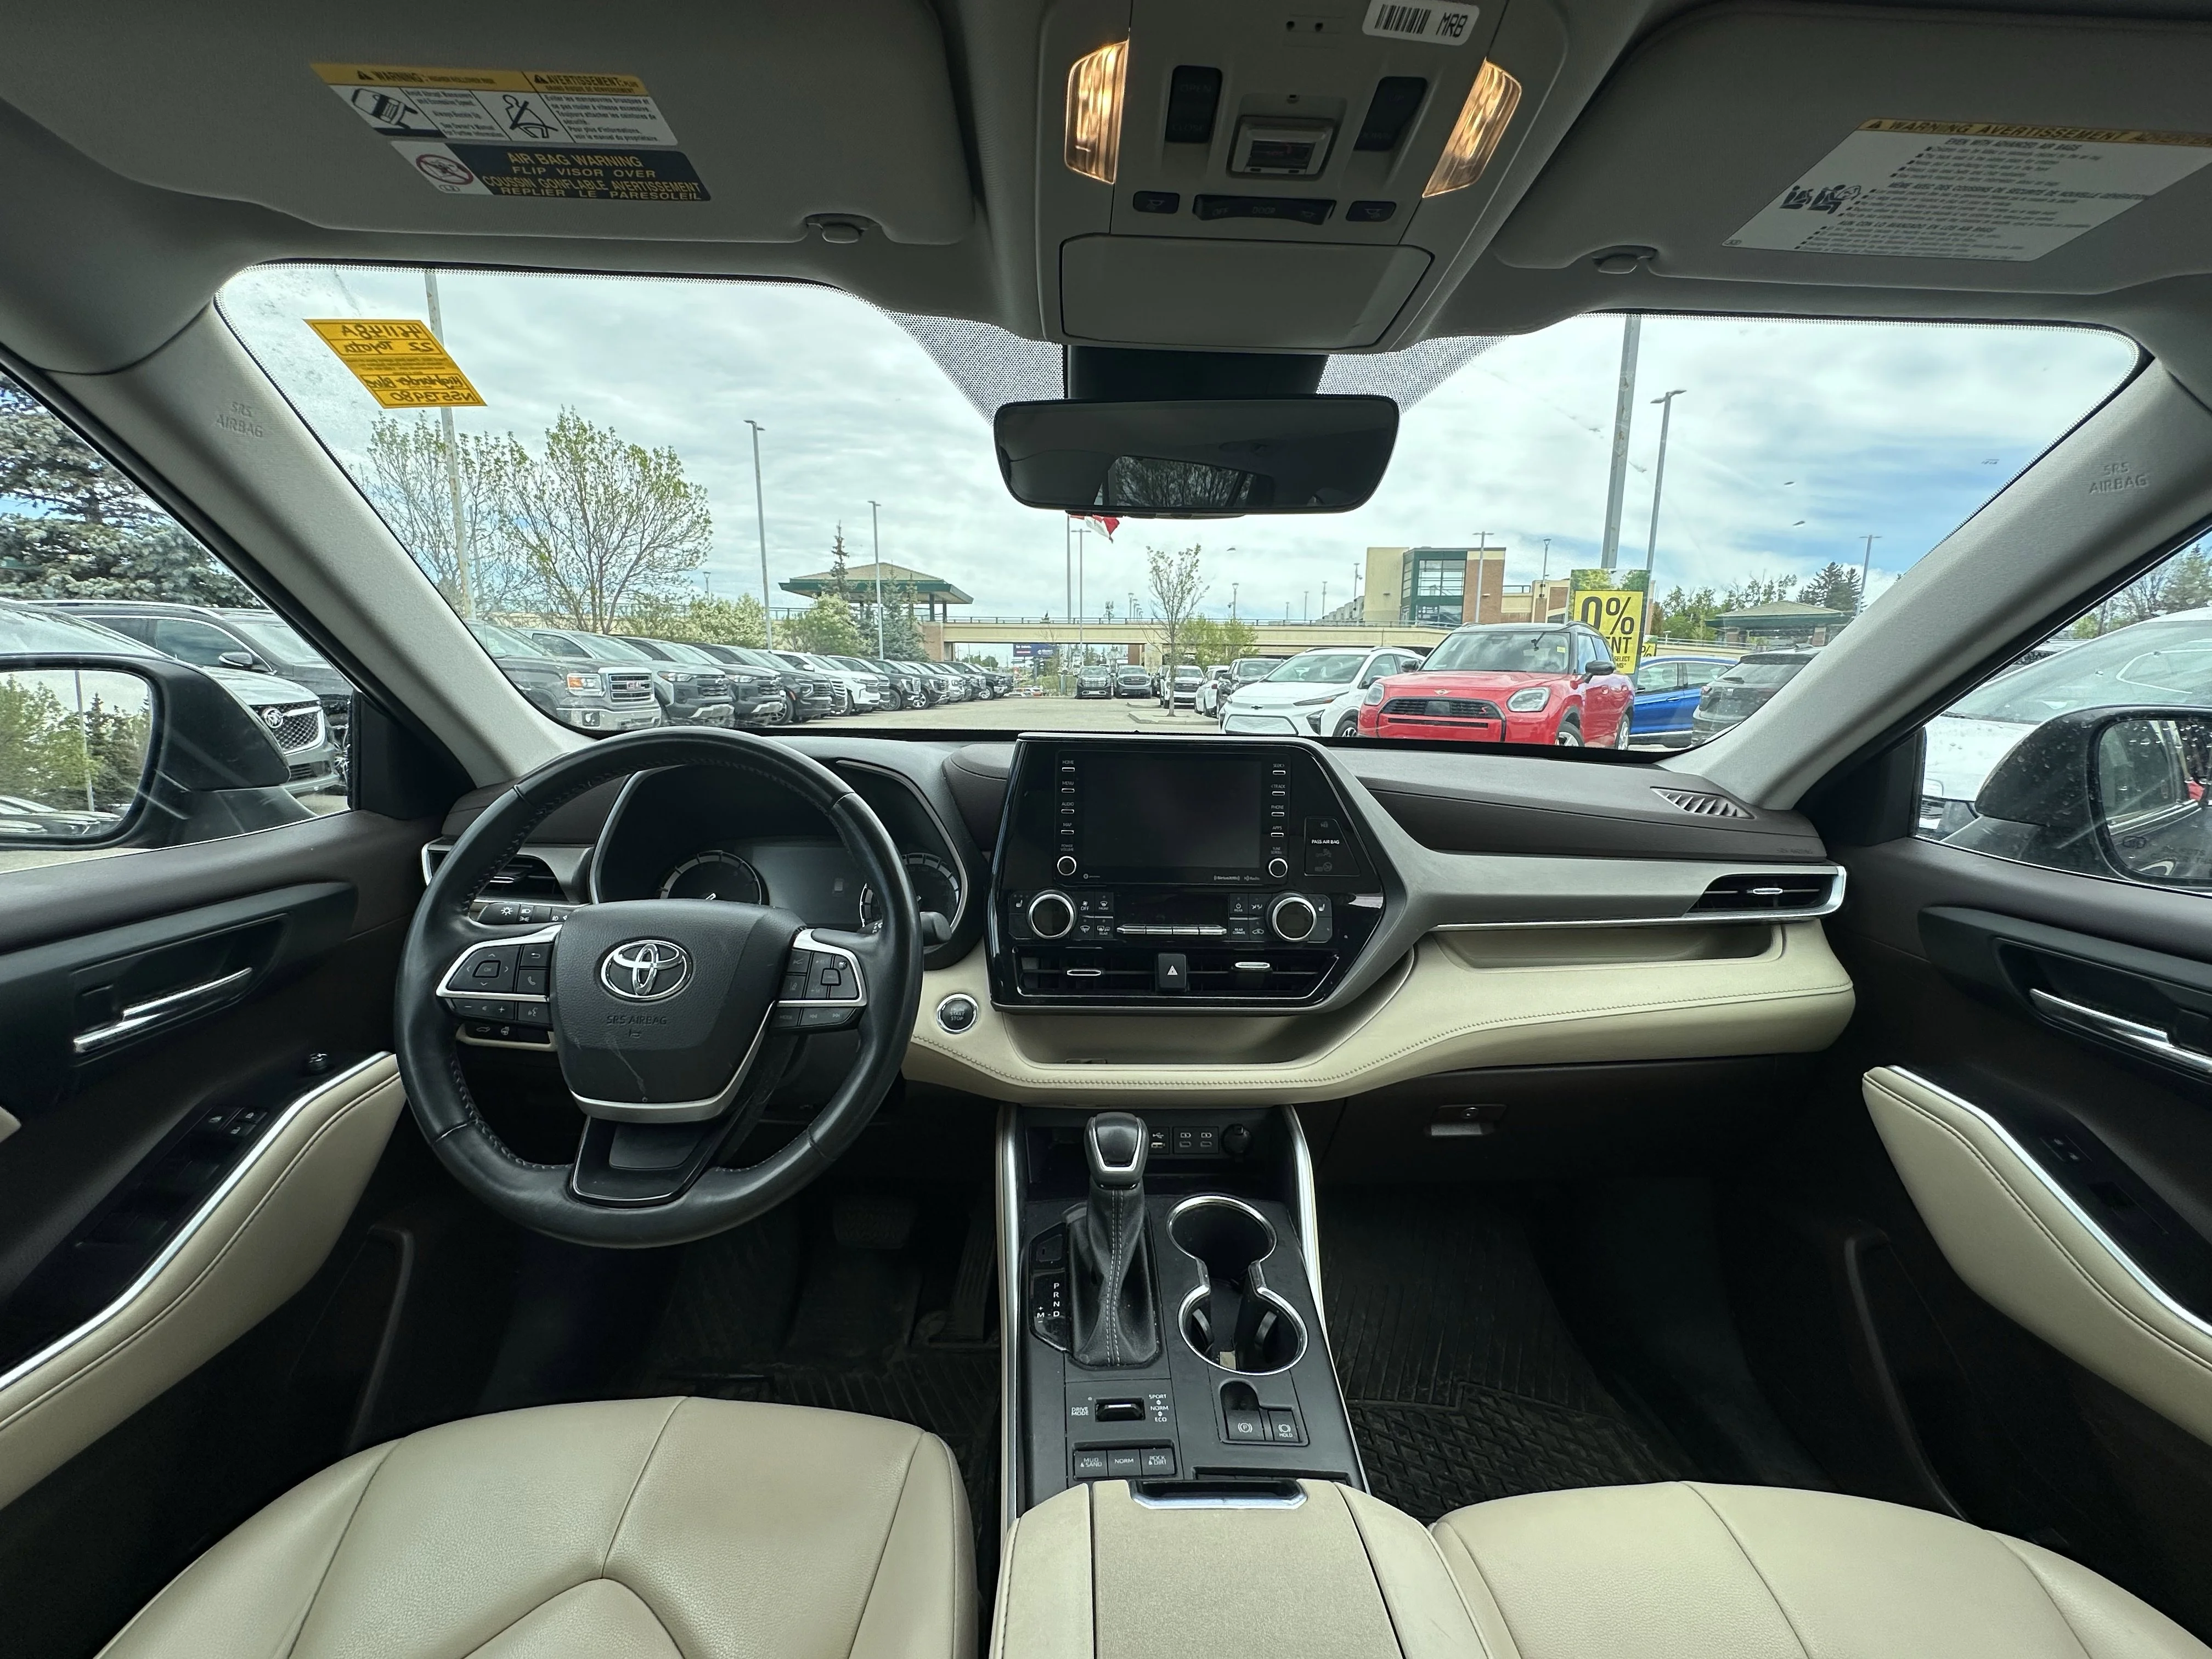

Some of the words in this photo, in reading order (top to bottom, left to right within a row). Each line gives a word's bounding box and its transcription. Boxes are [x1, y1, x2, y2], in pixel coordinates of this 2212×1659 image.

[1436, 12, 1468, 37] MRB
[1978, 125, 2129, 141] AVERTISSEMENT
[507, 152, 534, 165] AIR
[535, 153, 571, 166] BAG
[572, 154, 644, 167] WARNING
[556, 168, 602, 176] VISOR
[614, 170, 656, 178] OVER
[483, 176, 537, 188] COUSSIN
[539, 178, 608, 191] GONFLABLE
[612, 180, 701, 193] AVERTISSEMENT
[501, 187, 565, 197] REPLIER
[580, 190, 597, 198] LE
[610, 191, 702, 200] PARESOLEIL
[217, 414, 263, 438] AIRBAG
[2089, 474, 2148, 494] AIRBAG
[1581, 596, 1635, 635] 0%
[606, 1015, 625, 1024] SRS
[628, 1015, 667, 1025] AIRBAG
